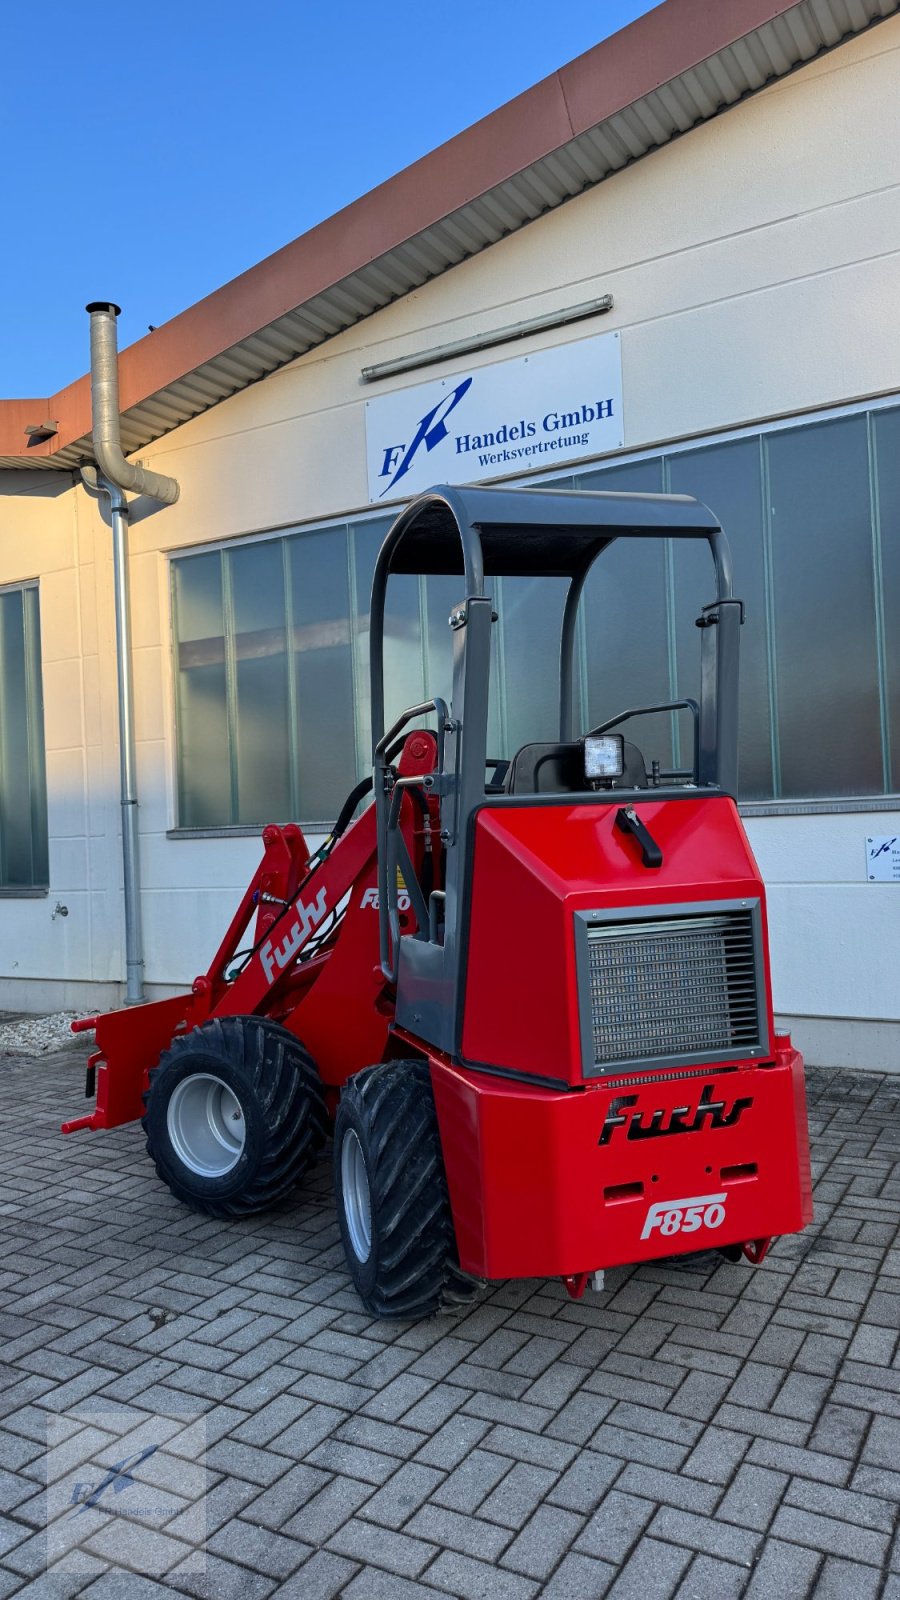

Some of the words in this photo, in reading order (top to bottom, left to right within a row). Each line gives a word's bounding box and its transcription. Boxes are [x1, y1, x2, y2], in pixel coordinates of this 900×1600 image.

[455, 420, 536, 454] Handels
[543, 398, 614, 432] GmbH
[478, 432, 590, 467] Werksvertretung
[259, 886, 327, 985] Fuchs
[597, 1084, 754, 1146] Fuchs
[640, 1193, 728, 1241] F850
